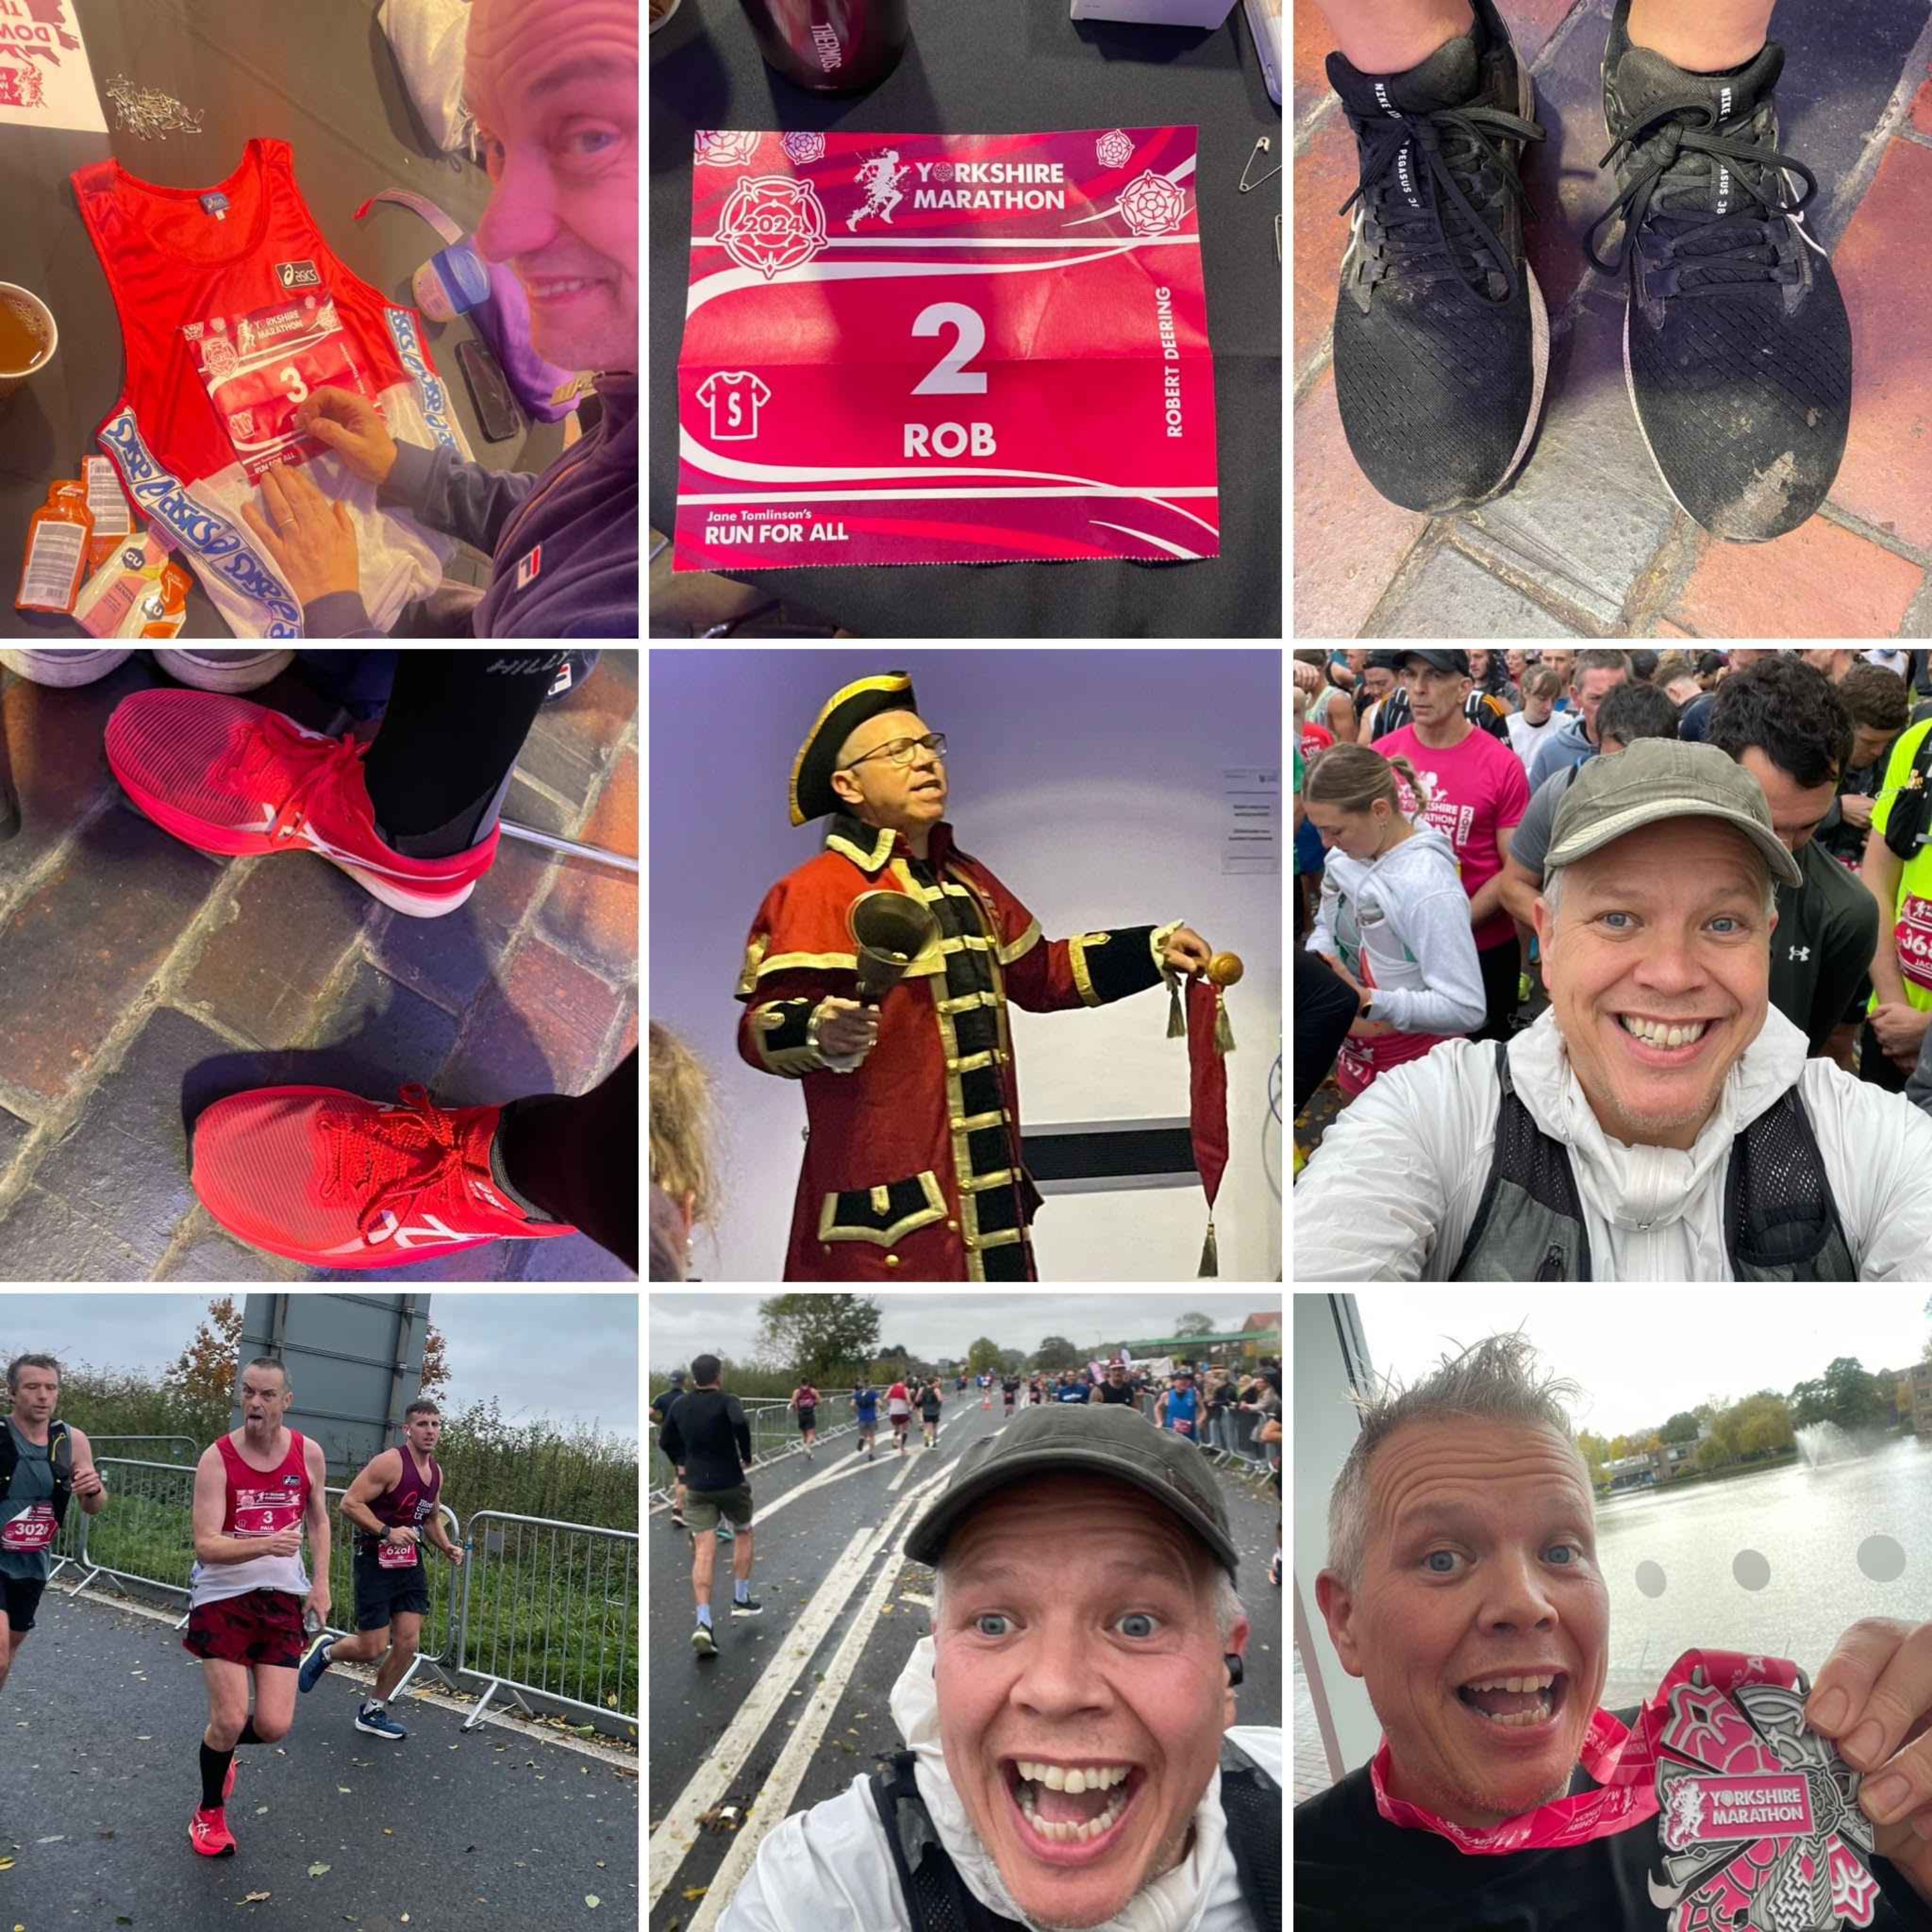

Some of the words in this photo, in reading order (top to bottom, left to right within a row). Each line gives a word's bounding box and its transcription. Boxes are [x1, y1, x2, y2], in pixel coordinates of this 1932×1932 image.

[1374, 83, 1392, 108] NIKE
[1720, 87, 1731, 115] NIKE
[914, 162, 1065, 184] YORKSHIRE
[1397, 148, 1412, 193] PEGASUS
[913, 189, 1065, 210] MARATHON
[743, 215, 804, 234] 2024
[1155, 286, 1180, 360] DEERING
[909, 301, 988, 395] 2
[279, 366, 308, 403] 3
[727, 392, 742, 428] S
[1164, 366, 1183, 438] ROBERT
[904, 422, 997, 458] ROB
[158, 492, 222, 546] asics
[707, 511, 737, 522] Jane
[741, 508, 812, 522] Tomlinson's
[705, 525, 754, 545] RUN
[759, 524, 803, 543] FOR
[809, 522, 849, 542] ALL
[126, 551, 142, 567] GU
[263, 1510, 274, 1524] 3
[1710, 1788, 1802, 1807] YORKSHIRE
[1713, 1806, 1804, 1825] MARATHON
